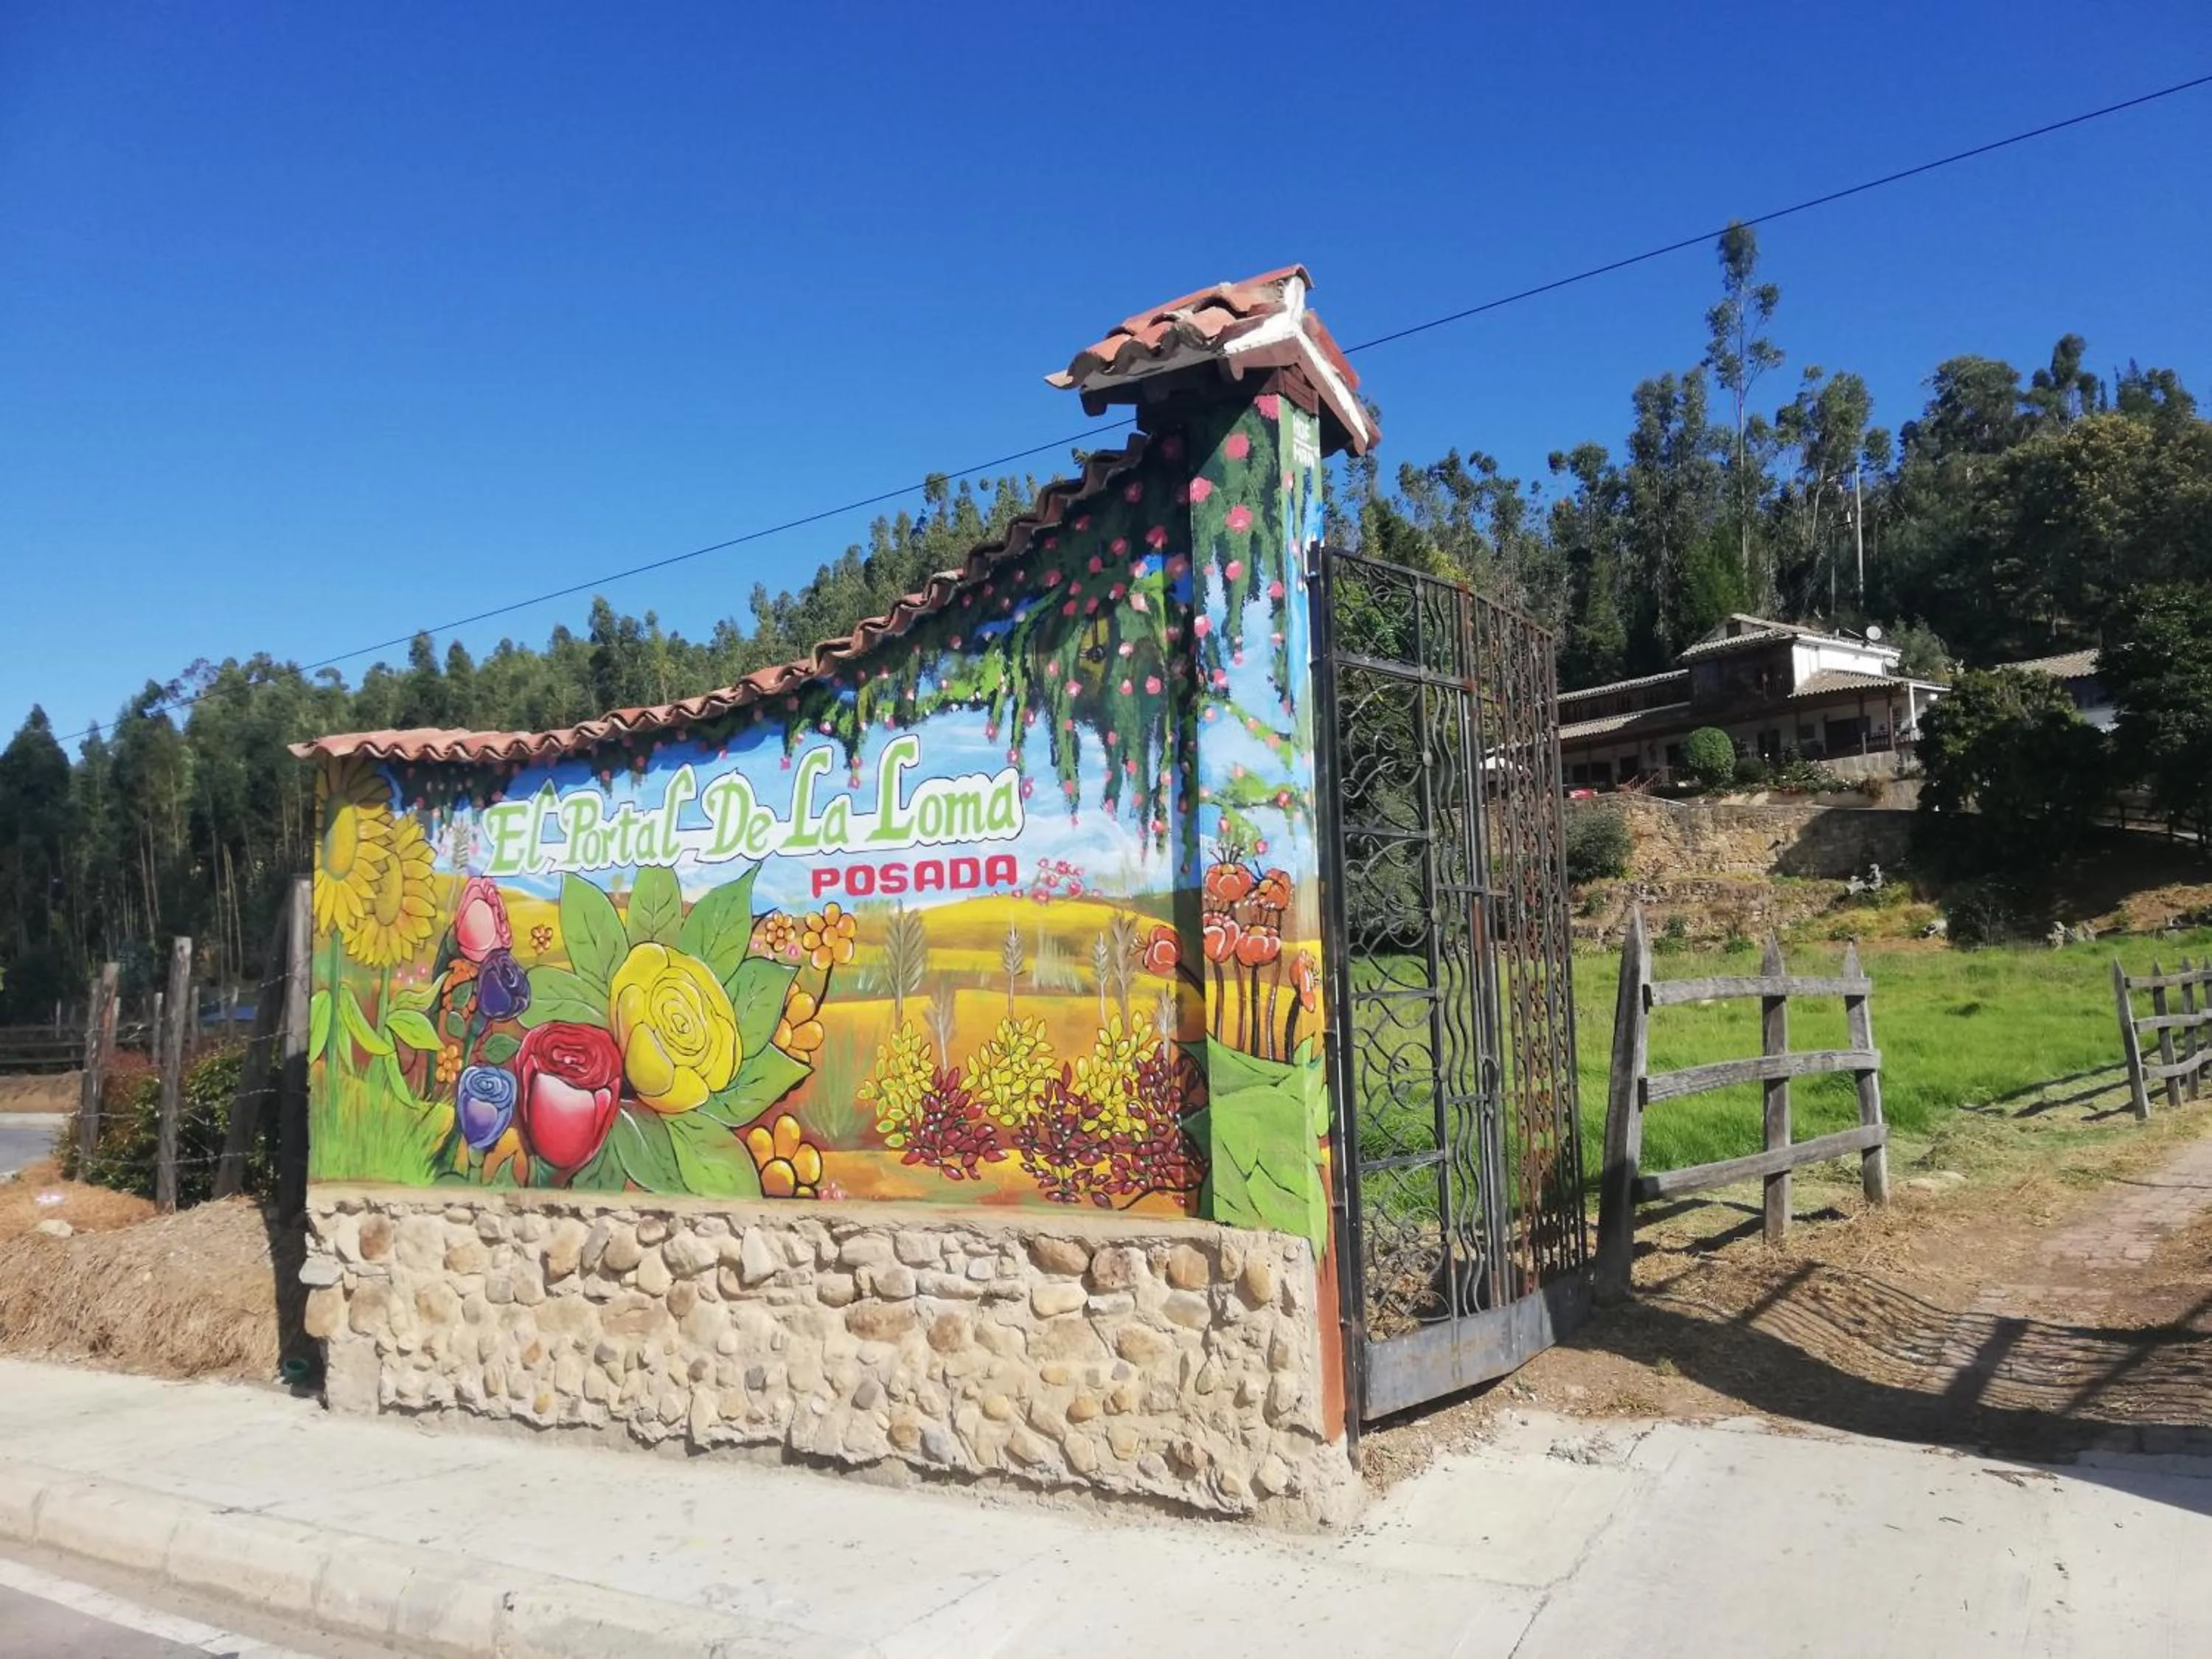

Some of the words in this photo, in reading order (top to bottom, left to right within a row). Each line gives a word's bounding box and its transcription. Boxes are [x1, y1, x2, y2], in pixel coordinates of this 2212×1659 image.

[485, 785, 553, 872] El
[561, 769, 695, 866] Portal
[706, 776, 773, 856] De
[779, 751, 849, 849] La
[864, 740, 1018, 844] Loma
[811, 853, 1018, 899] POSADA
